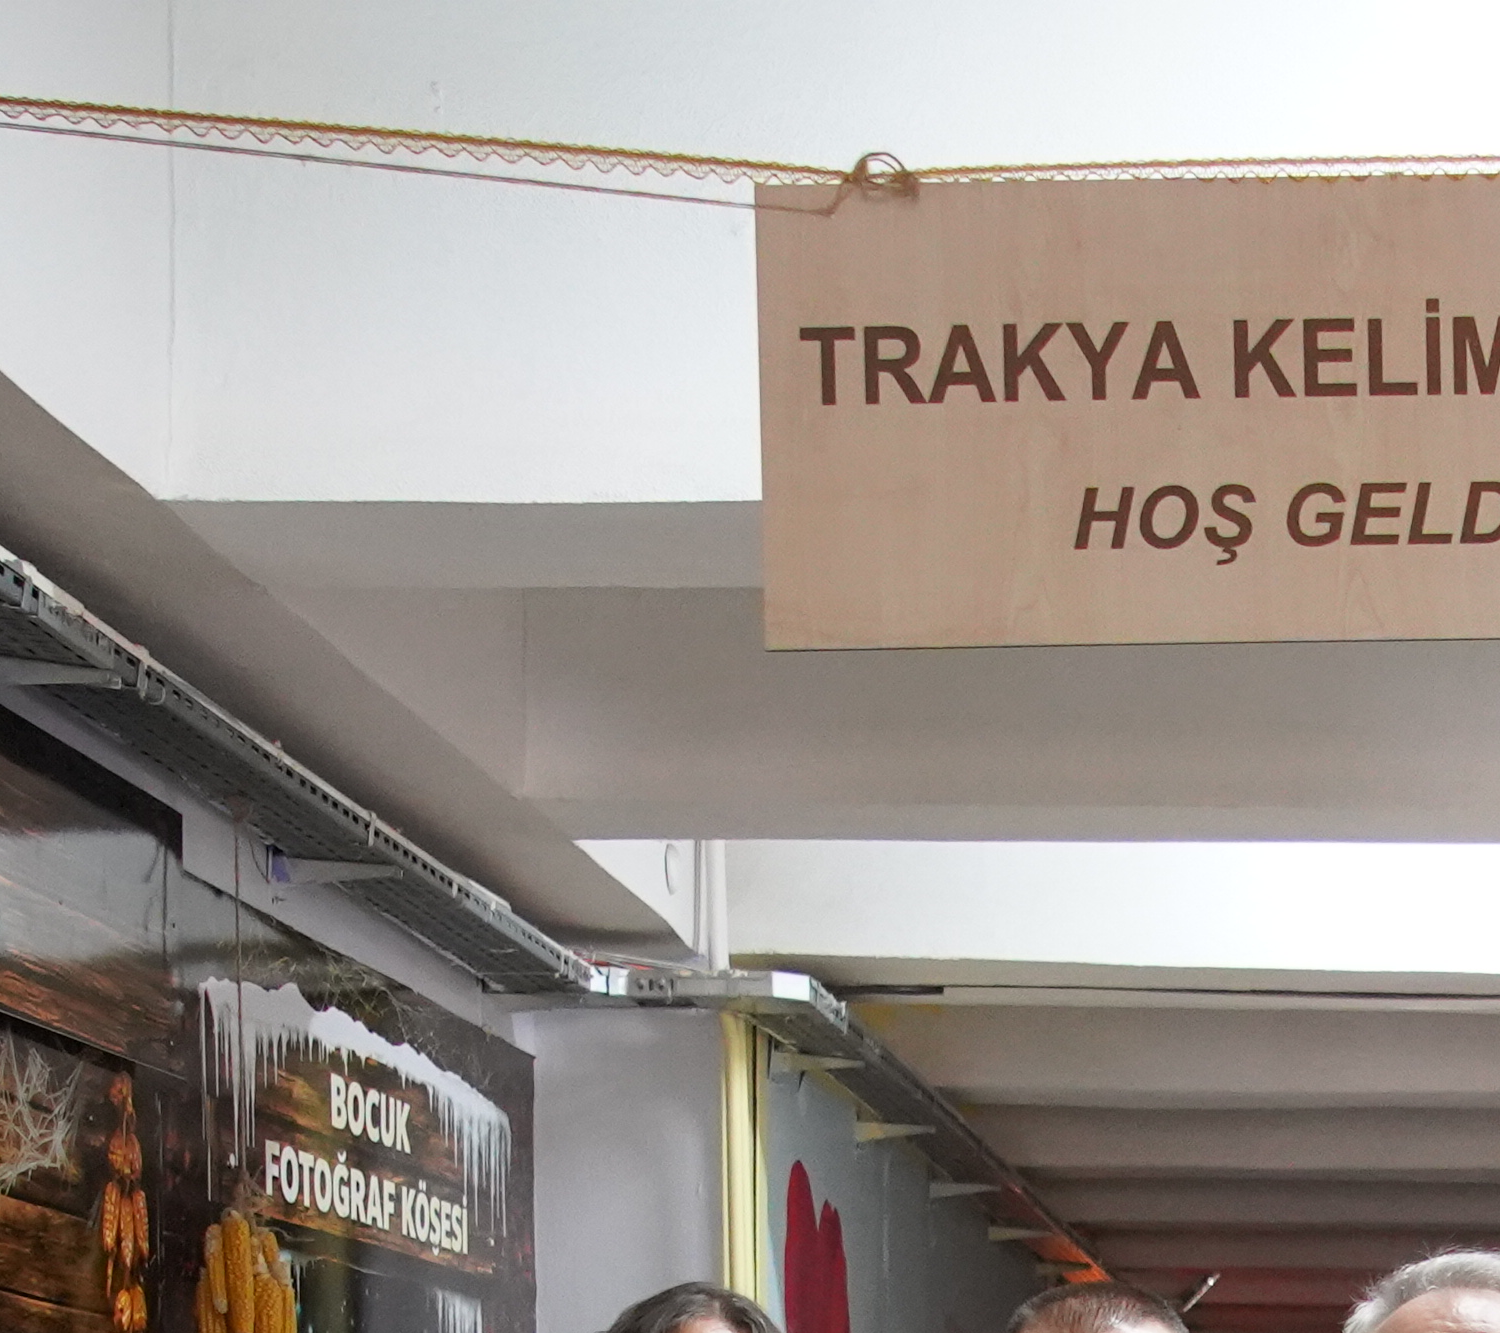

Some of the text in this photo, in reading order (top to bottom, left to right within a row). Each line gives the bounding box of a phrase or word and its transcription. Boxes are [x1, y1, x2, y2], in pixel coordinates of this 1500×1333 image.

[798, 320, 1201, 406] TRAKYA
[1073, 483, 1257, 566] HOŞ
[329, 1071, 412, 1155] BOCUK
[264, 1139, 468, 1256] FOTOĞRAF KÖŞESİ
